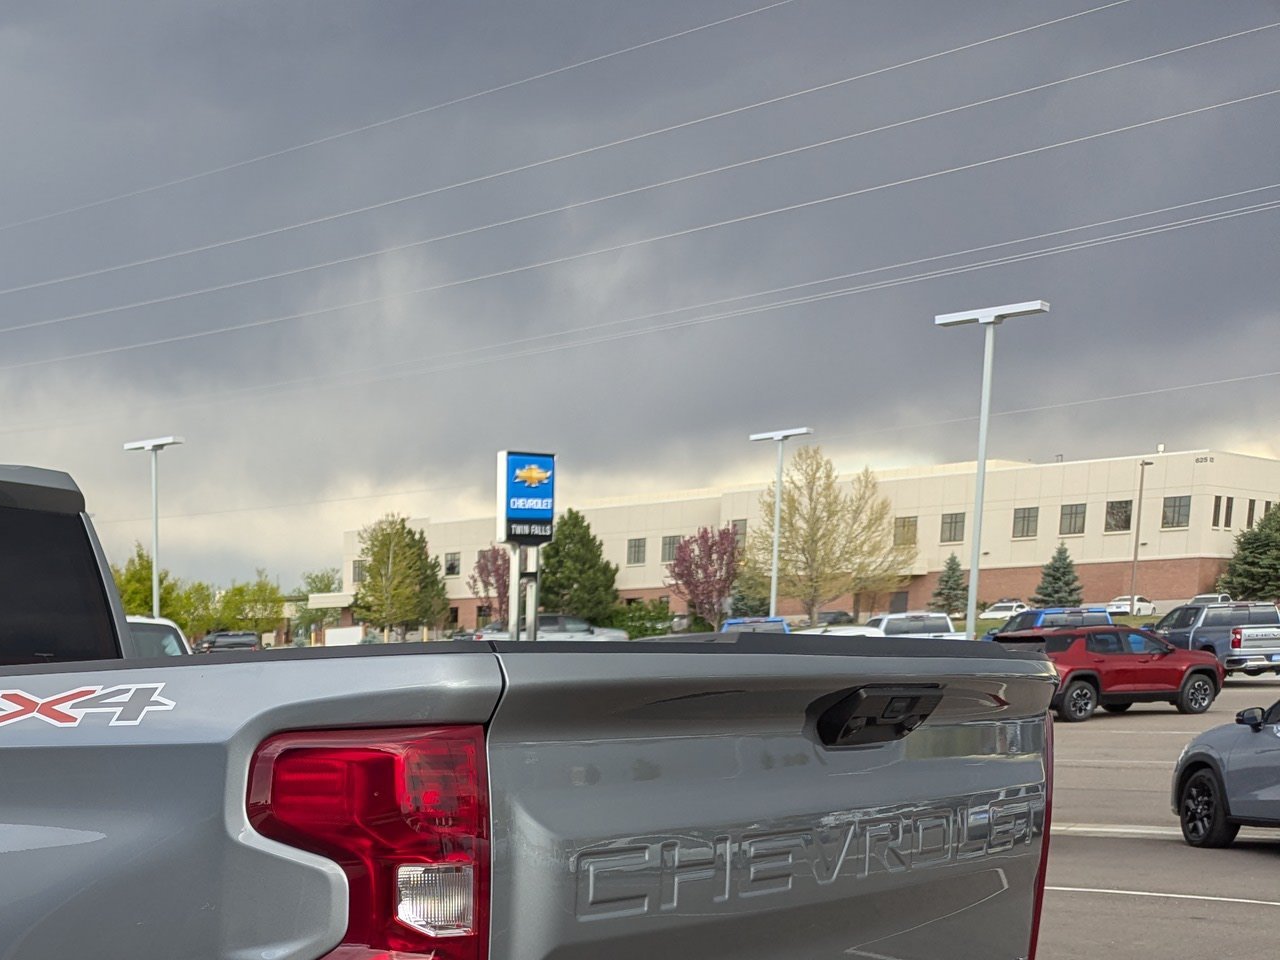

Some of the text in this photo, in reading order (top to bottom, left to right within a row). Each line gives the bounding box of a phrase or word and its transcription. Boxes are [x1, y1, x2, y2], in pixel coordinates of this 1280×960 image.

[510, 498, 553, 510] CHEVROLET
[511, 523, 552, 536] TWIN FALLS
[573, 794, 1044, 922] CHEVROLET
